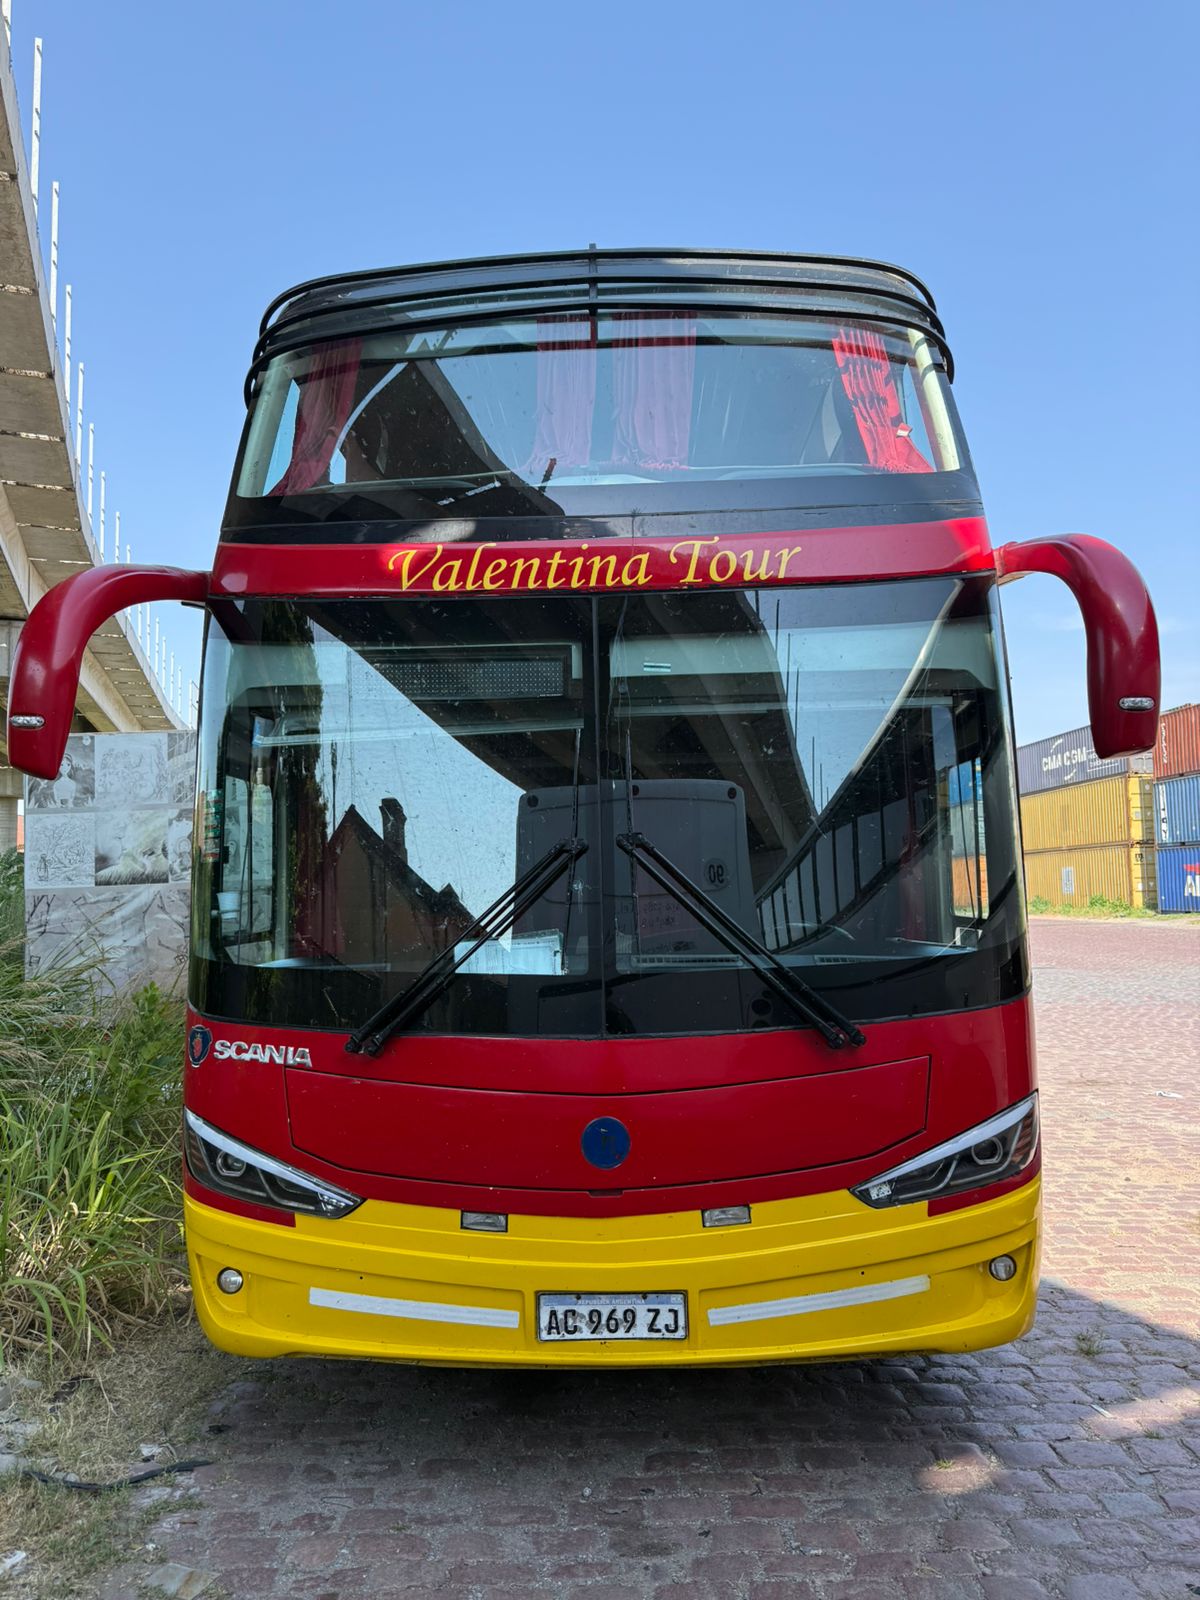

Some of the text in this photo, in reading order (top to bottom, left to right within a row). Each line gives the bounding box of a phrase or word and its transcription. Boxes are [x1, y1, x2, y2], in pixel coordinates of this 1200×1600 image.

[388, 536, 802, 591] Valentina Tour
[1042, 754, 1062, 771] CMA
[1064, 747, 1087, 765] CGM
[214, 1040, 313, 1068] SCANIA
[547, 1309, 679, 1335] AC 969 ZJ
